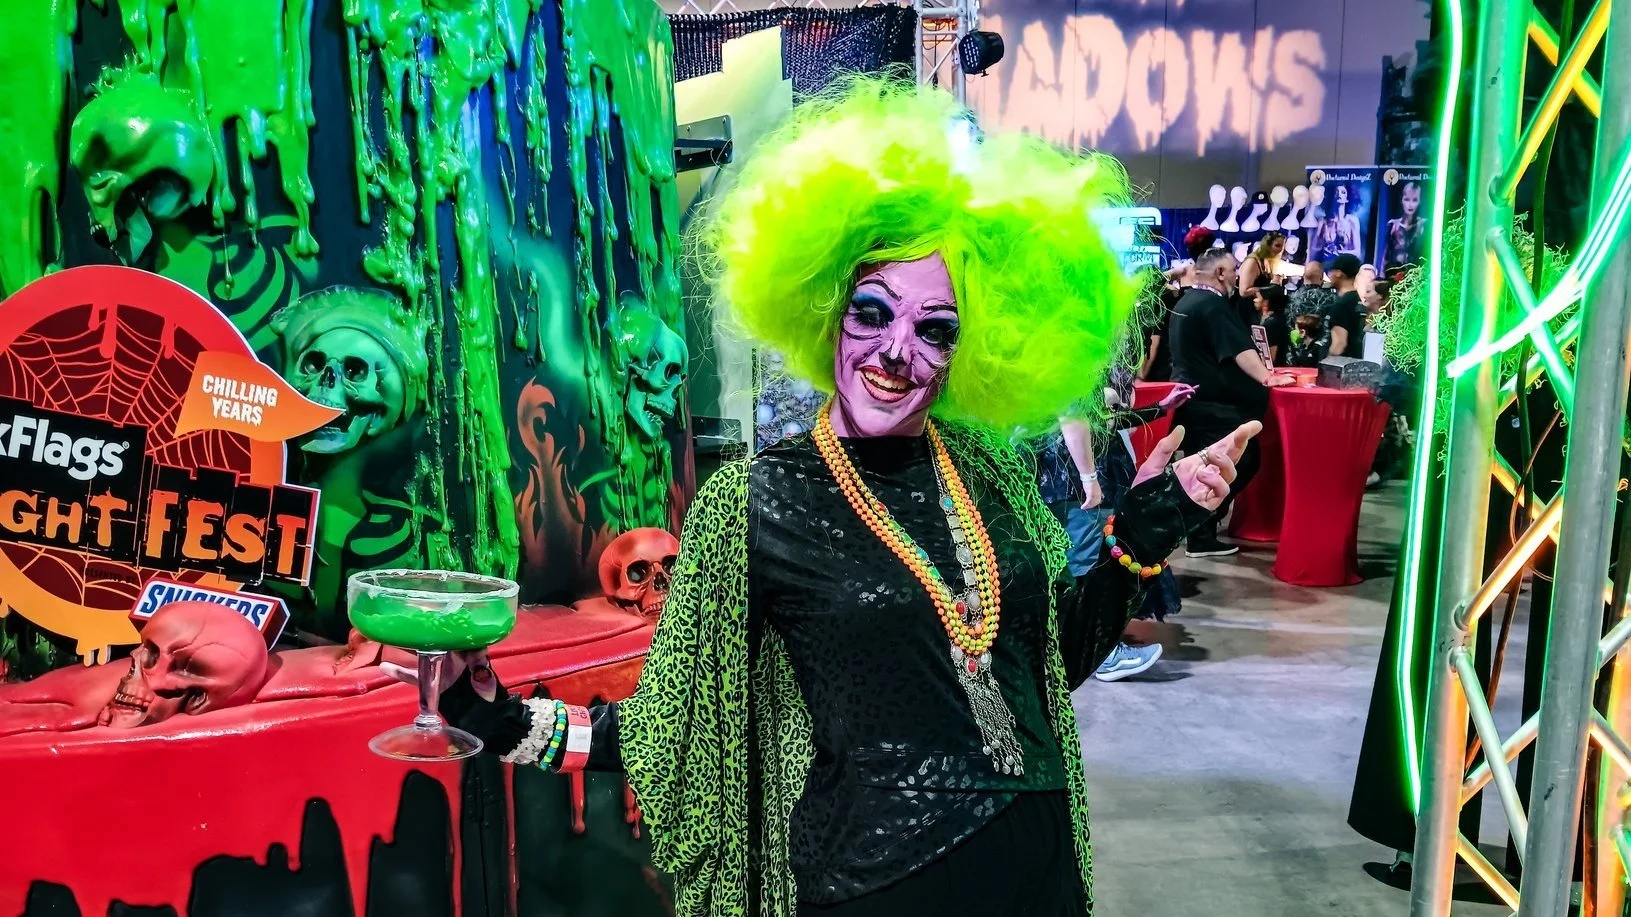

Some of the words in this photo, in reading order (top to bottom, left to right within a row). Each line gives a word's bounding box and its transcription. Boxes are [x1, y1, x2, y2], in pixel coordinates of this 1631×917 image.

[202, 374, 279, 408] CHILLING
[211, 396, 263, 427] YEARS
[145, 489, 306, 575] FEST
